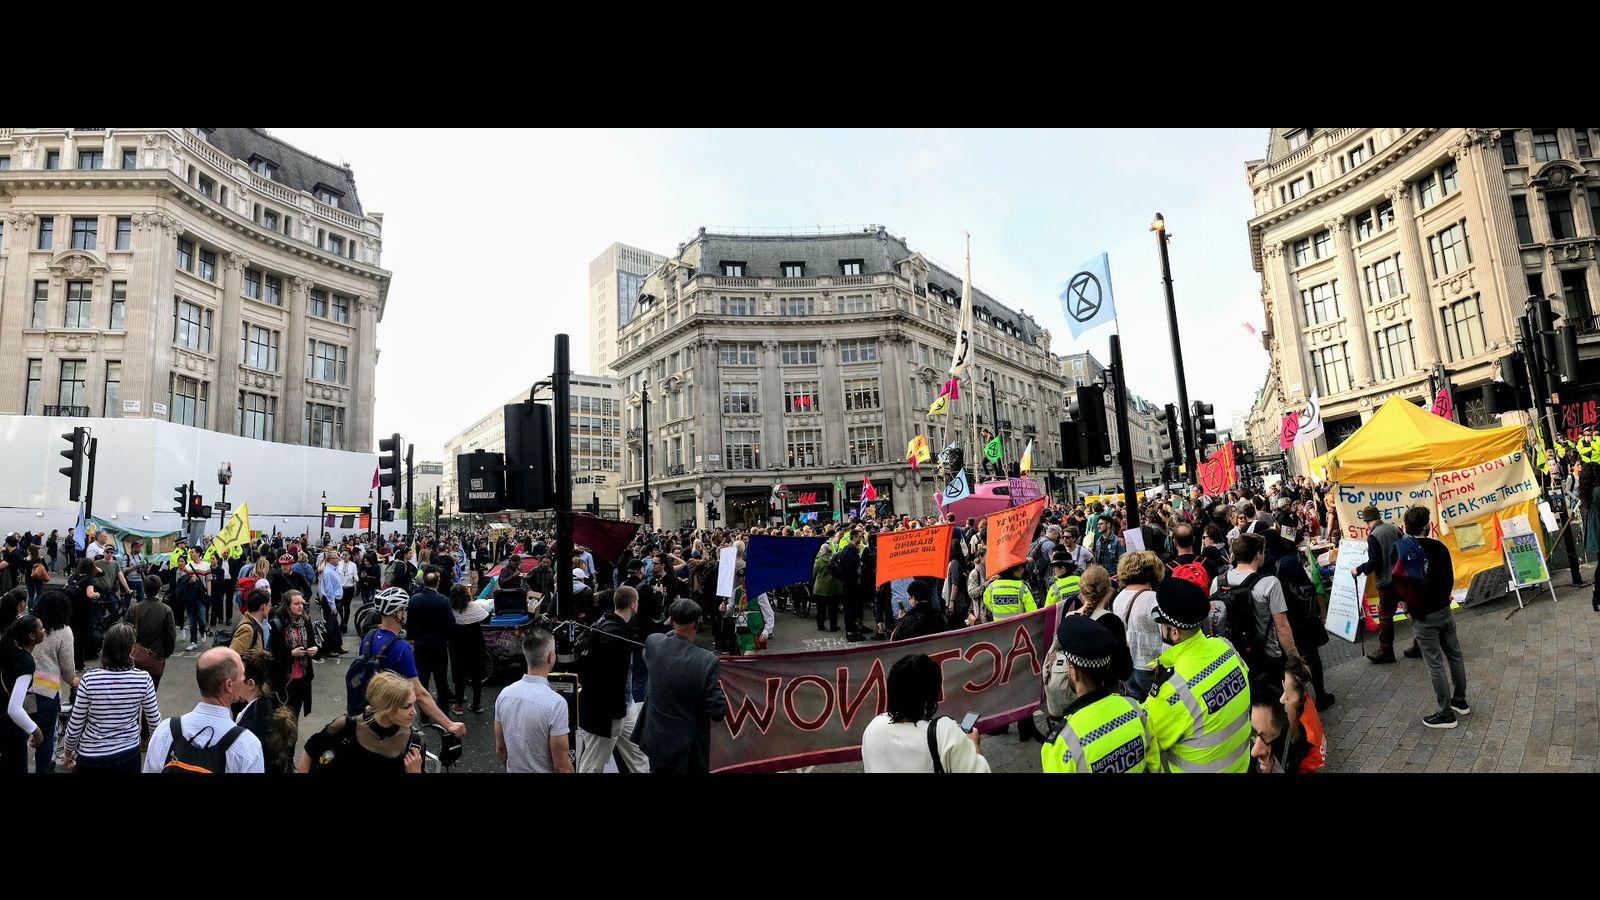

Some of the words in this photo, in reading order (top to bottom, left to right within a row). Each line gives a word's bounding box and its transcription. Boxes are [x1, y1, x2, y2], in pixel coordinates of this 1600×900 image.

[1582, 400, 1597, 424] AS
[1508, 452, 1521, 464] IS
[1339, 485, 1366, 503] For
[1369, 490, 1403, 506] your
[1409, 490, 1433, 499] own
[1478, 492, 1498, 504] THE
[1496, 479, 1533, 500] TRUTH
[1511, 544, 1534, 554] REBEL
[1203, 667, 1241, 701] METROPOLITAN
[1208, 677, 1246, 713] POLICE
[1092, 736, 1143, 773] METROPOLITAN
